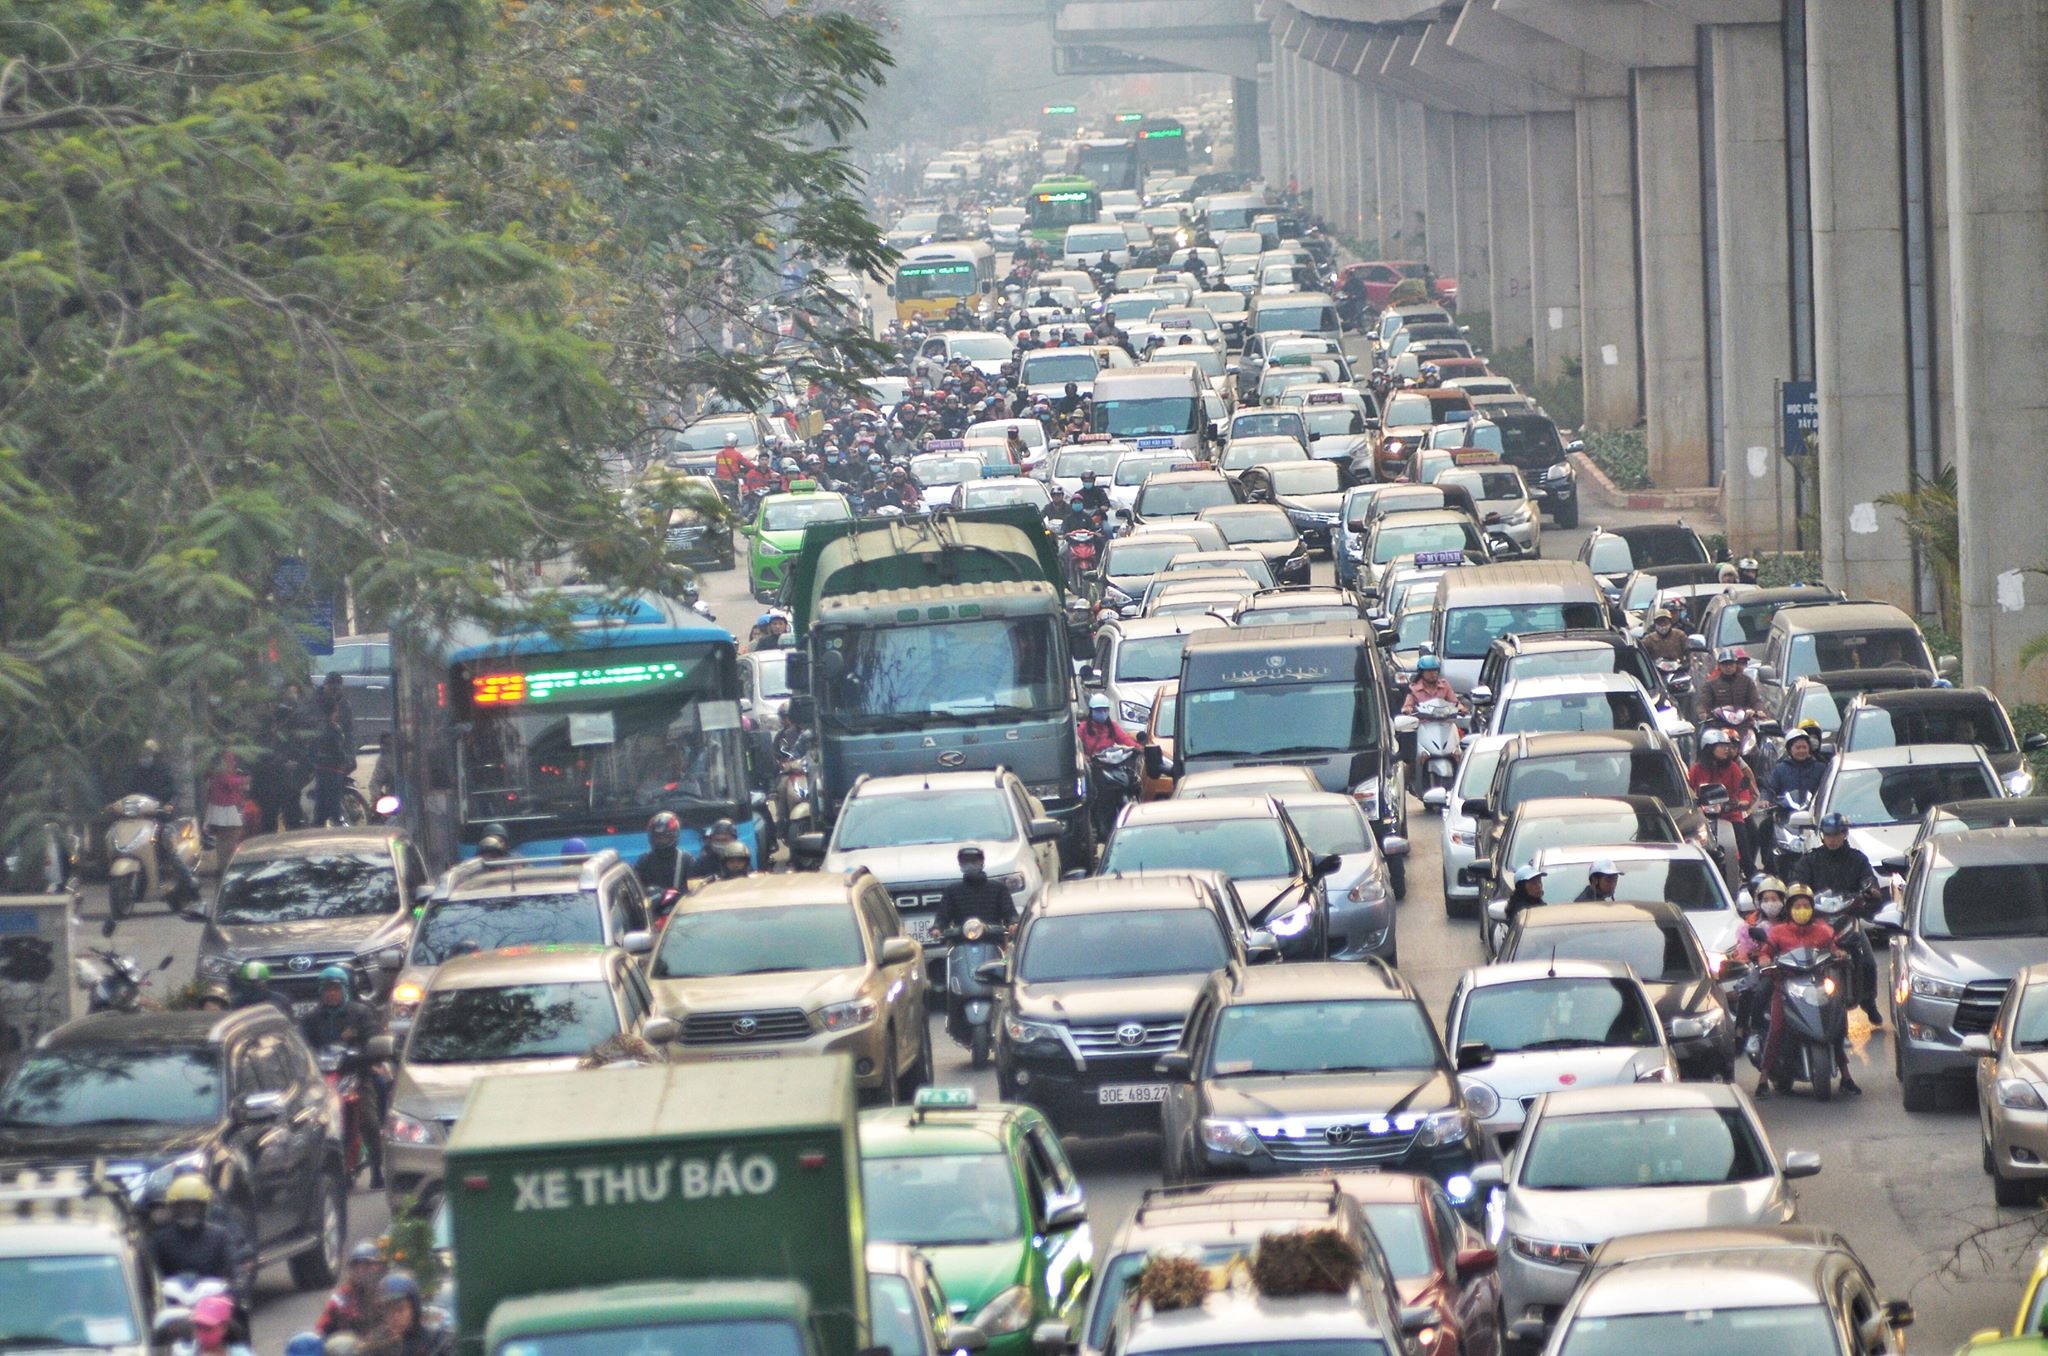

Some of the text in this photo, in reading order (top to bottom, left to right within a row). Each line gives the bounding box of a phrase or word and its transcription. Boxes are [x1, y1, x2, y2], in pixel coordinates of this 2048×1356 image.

[1222, 666, 1330, 681] LIMOUSINE
[513, 1150, 778, 1211] XE THƯ BÁO
